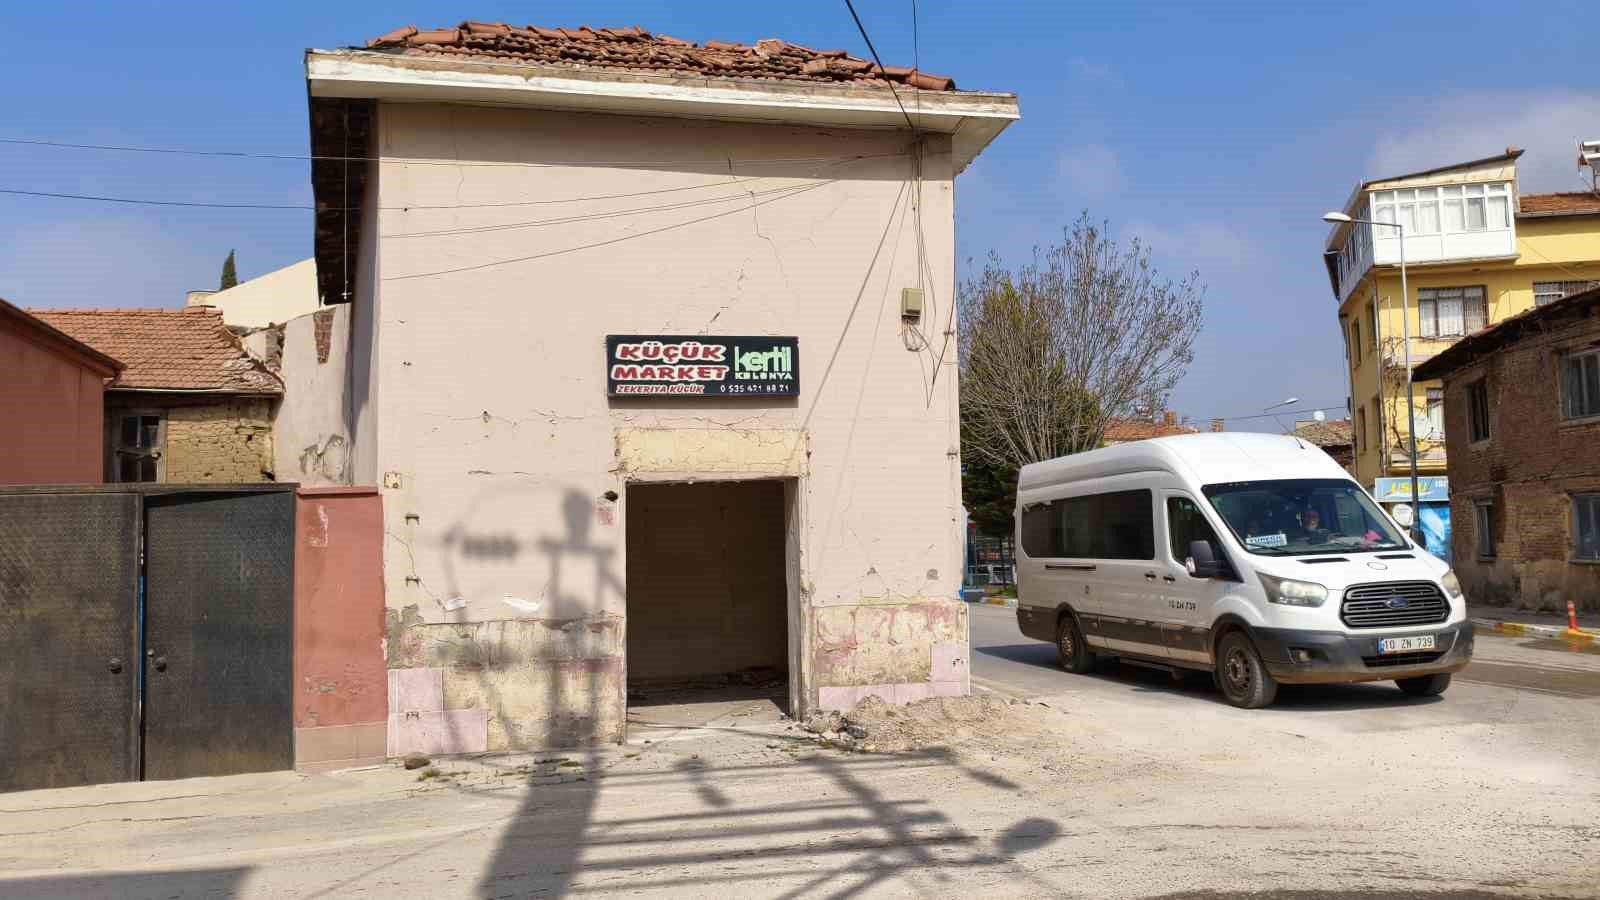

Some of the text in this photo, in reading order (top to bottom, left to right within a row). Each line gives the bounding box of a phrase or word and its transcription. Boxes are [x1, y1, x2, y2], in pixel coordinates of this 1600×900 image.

[616, 341, 726, 363] KÜÇÜK
[734, 346, 791, 372] kertil
[611, 365, 729, 381] MARKET
[1385, 637, 1432, 649] 10 ZN 739
